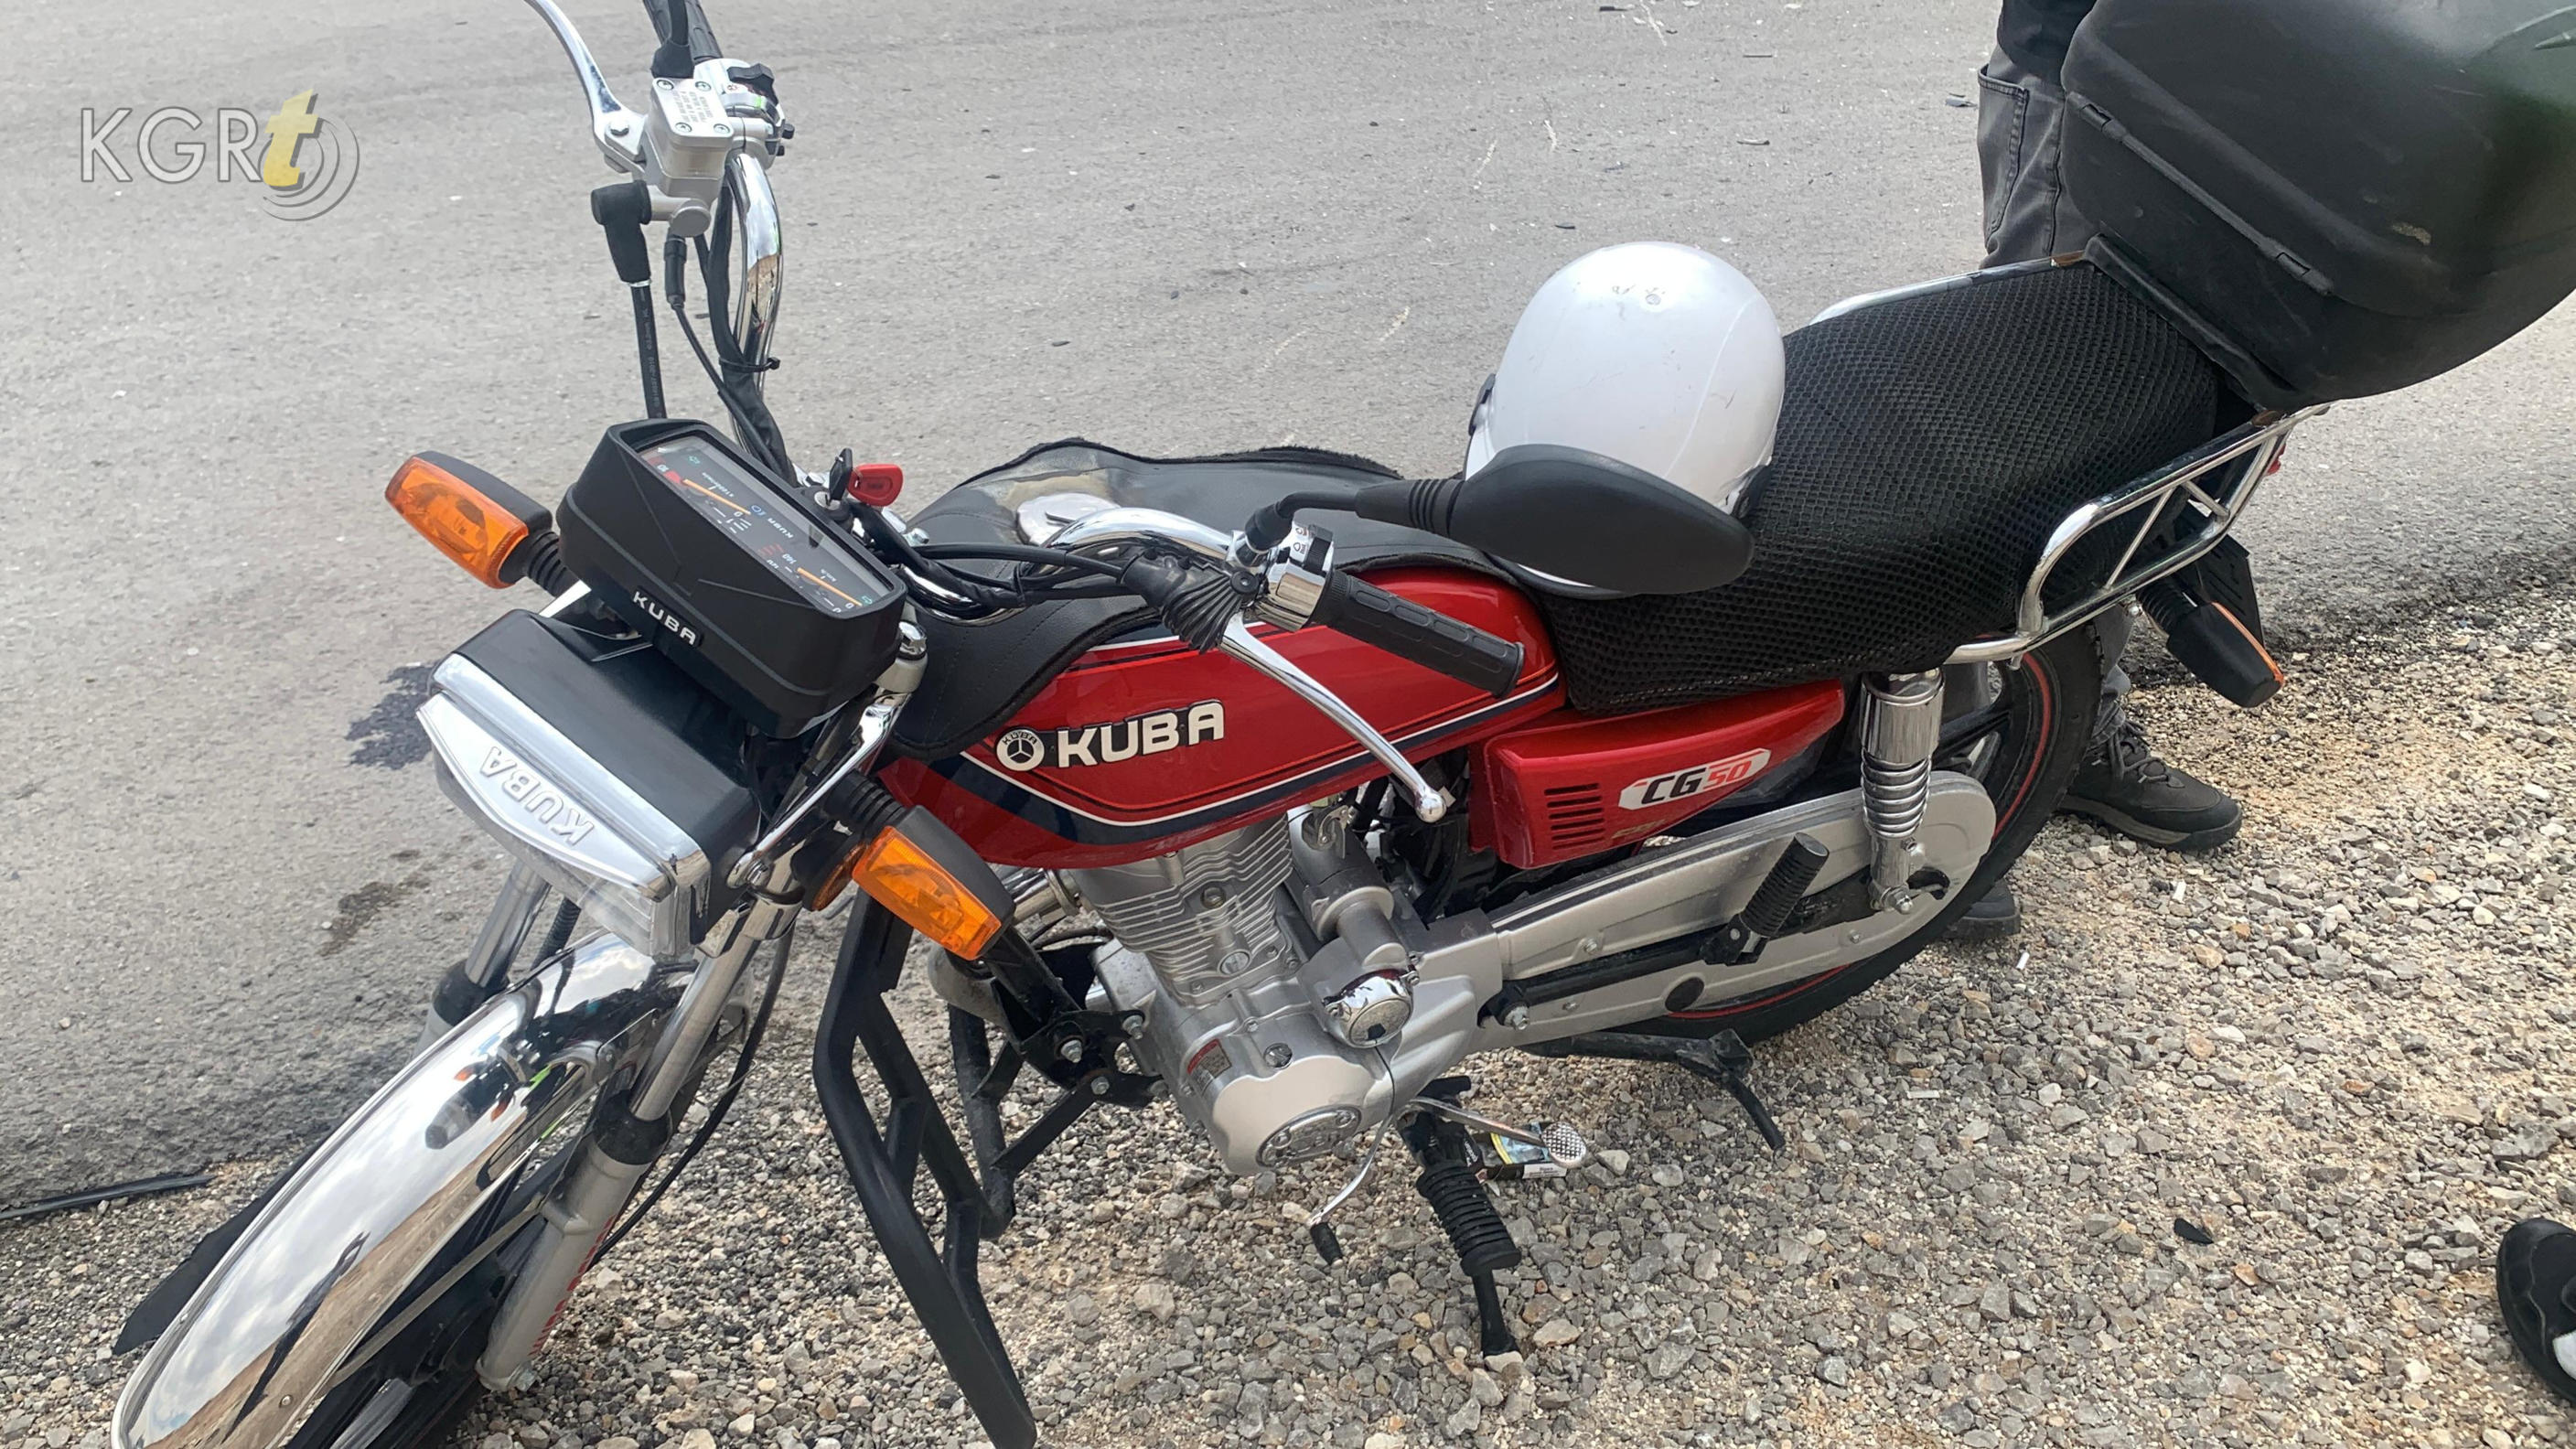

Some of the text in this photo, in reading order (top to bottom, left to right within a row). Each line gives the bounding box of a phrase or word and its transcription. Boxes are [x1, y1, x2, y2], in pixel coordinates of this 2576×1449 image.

[767, 517, 794, 539] KUBA
[633, 591, 696, 645] KUBA
[1002, 731, 1037, 746] KUBA
[1057, 700, 1224, 767] KUBA
[480, 746, 594, 845] KUBA
